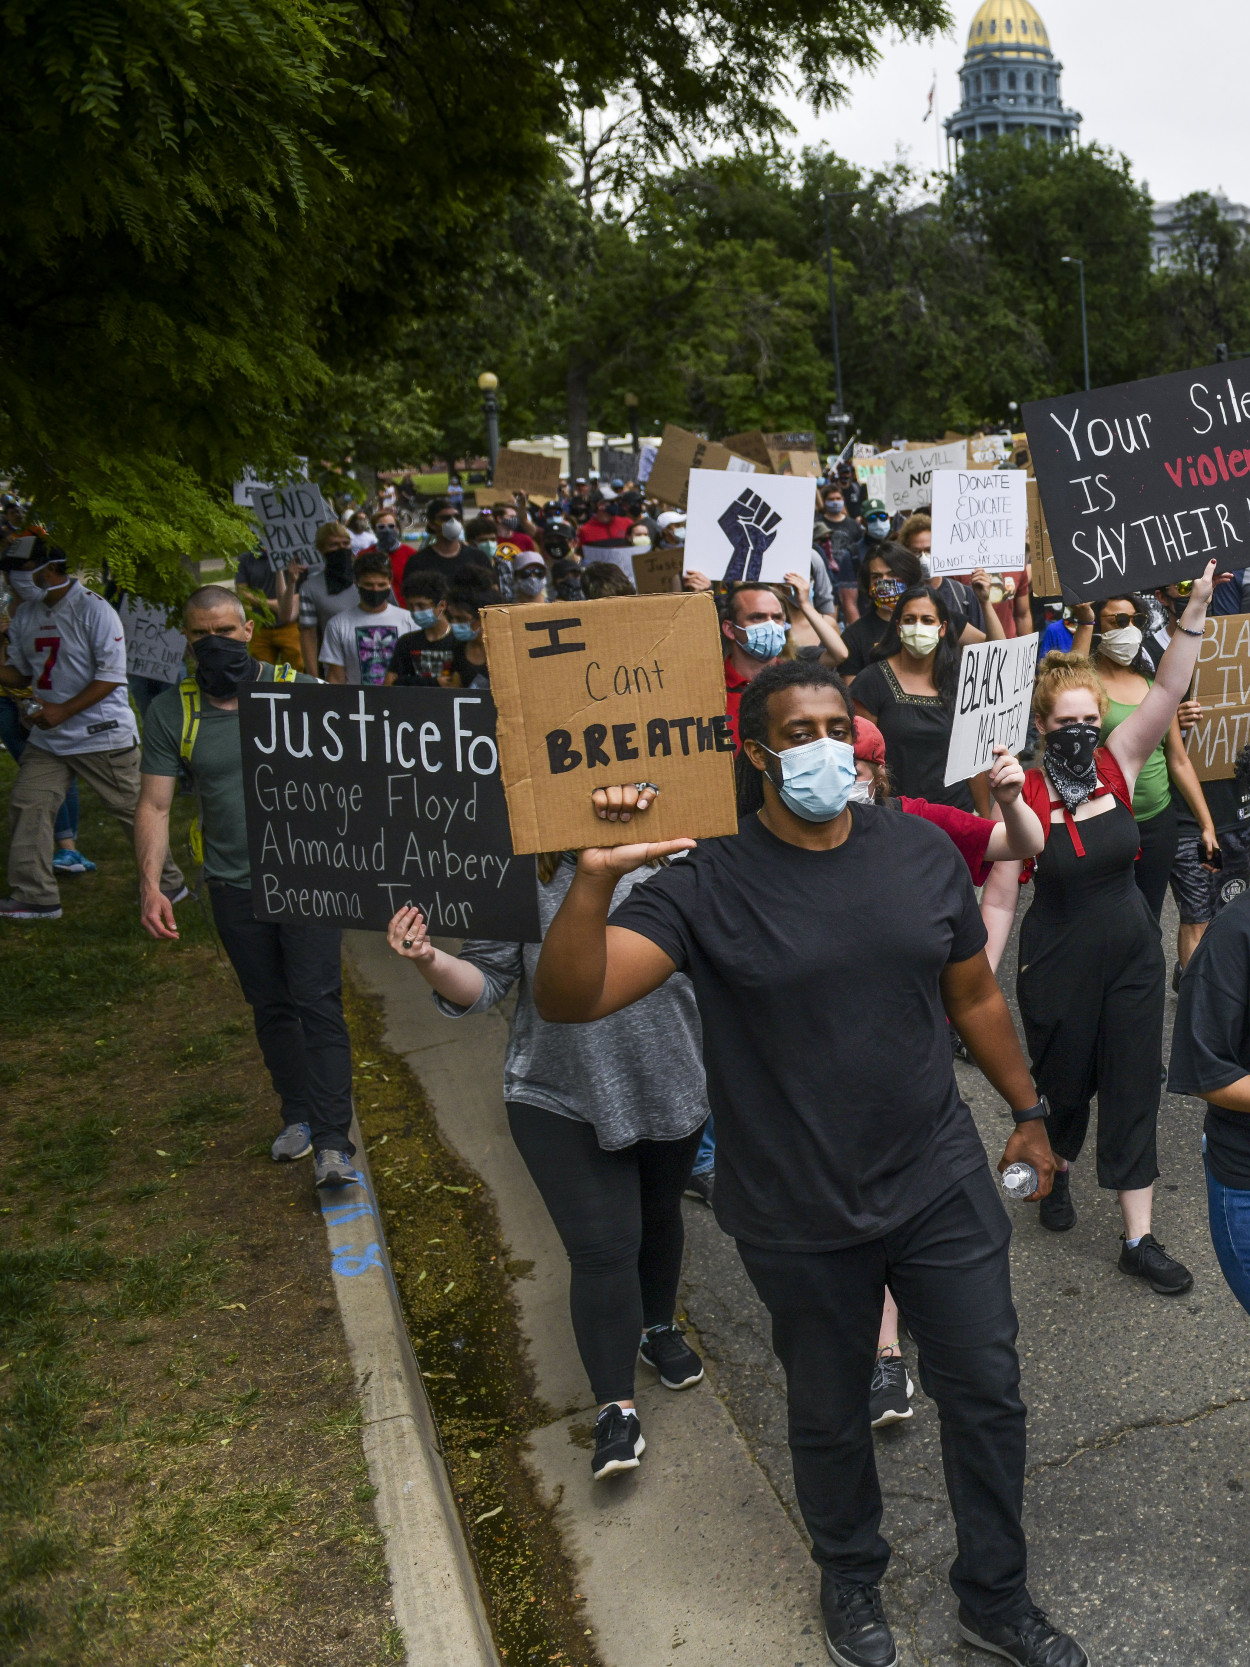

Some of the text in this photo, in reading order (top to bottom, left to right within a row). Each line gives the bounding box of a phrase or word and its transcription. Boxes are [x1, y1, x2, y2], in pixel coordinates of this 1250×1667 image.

[1050, 409, 1152, 461] Your
[920, 451, 953, 468] WILL
[261, 490, 316, 519] END
[958, 473, 1010, 495] DONATE
[1069, 473, 1116, 514] IS
[956, 495, 1013, 521] EDUCATE
[950, 519, 1014, 544] ADVOCATE
[977, 540, 988, 554] &
[1072, 523, 1126, 585] SAY
[1130, 503, 1243, 565] THEIR
[645, 558, 682, 573] Just
[947, 555, 964, 568] NOT
[994, 553, 1025, 566] SILENT
[128, 641, 157, 658] ACK
[135, 617, 169, 647] FOR
[525, 617, 586, 659] I
[34, 631, 61, 690] 7
[586, 659, 665, 701] Cant
[960, 644, 1008, 715] BLACK
[251, 690, 499, 775] Justice Fo
[545, 714, 737, 775] BREATHE
[973, 701, 1023, 766] MATTER
[255, 764, 476, 836] George Floyd
[261, 821, 511, 888] Ahmaud Arbery
[263, 874, 364, 920] Breonna
